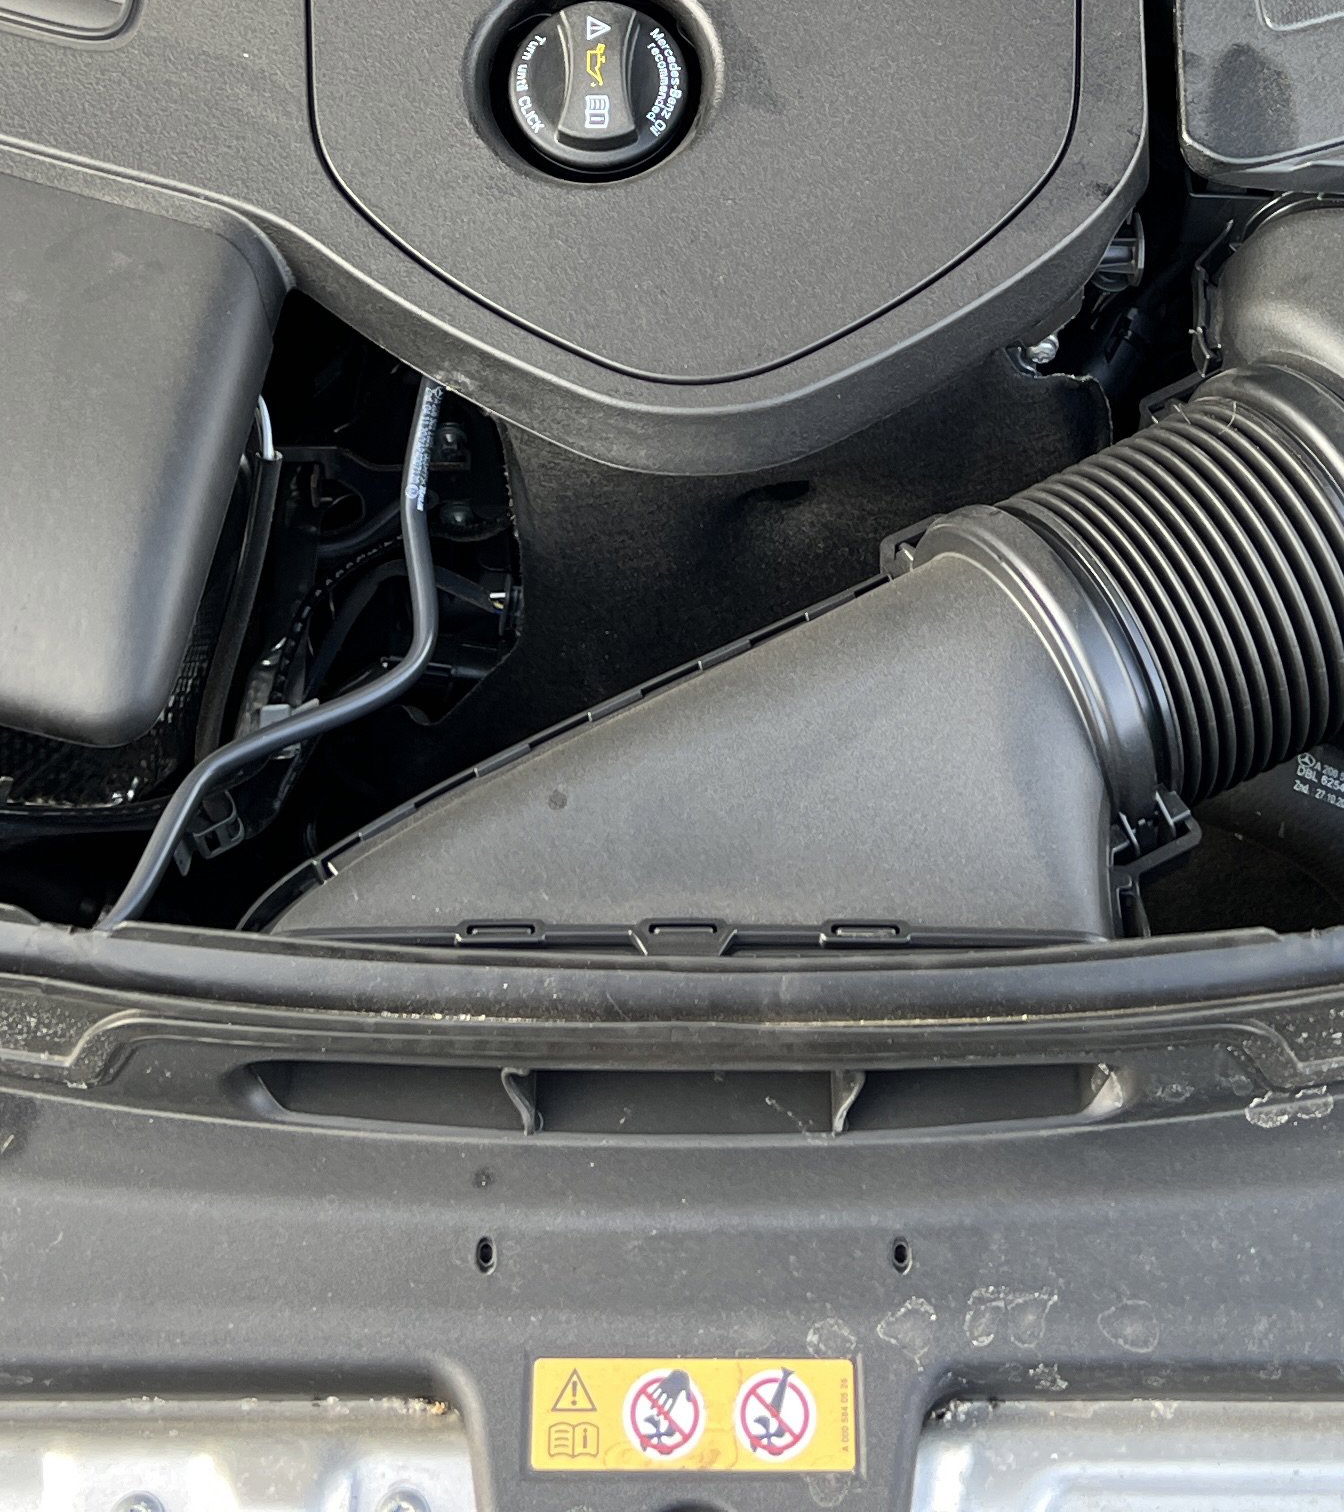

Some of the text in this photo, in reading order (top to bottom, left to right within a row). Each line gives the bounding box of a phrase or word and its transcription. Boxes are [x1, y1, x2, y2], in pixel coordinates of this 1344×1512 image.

[516, 34, 547, 134] Turn until CLICK
[646, 42, 668, 121] recommended
[649, 27, 683, 137] Mercedes-Benz Oil
[1296, 765, 1318, 784] DBL
